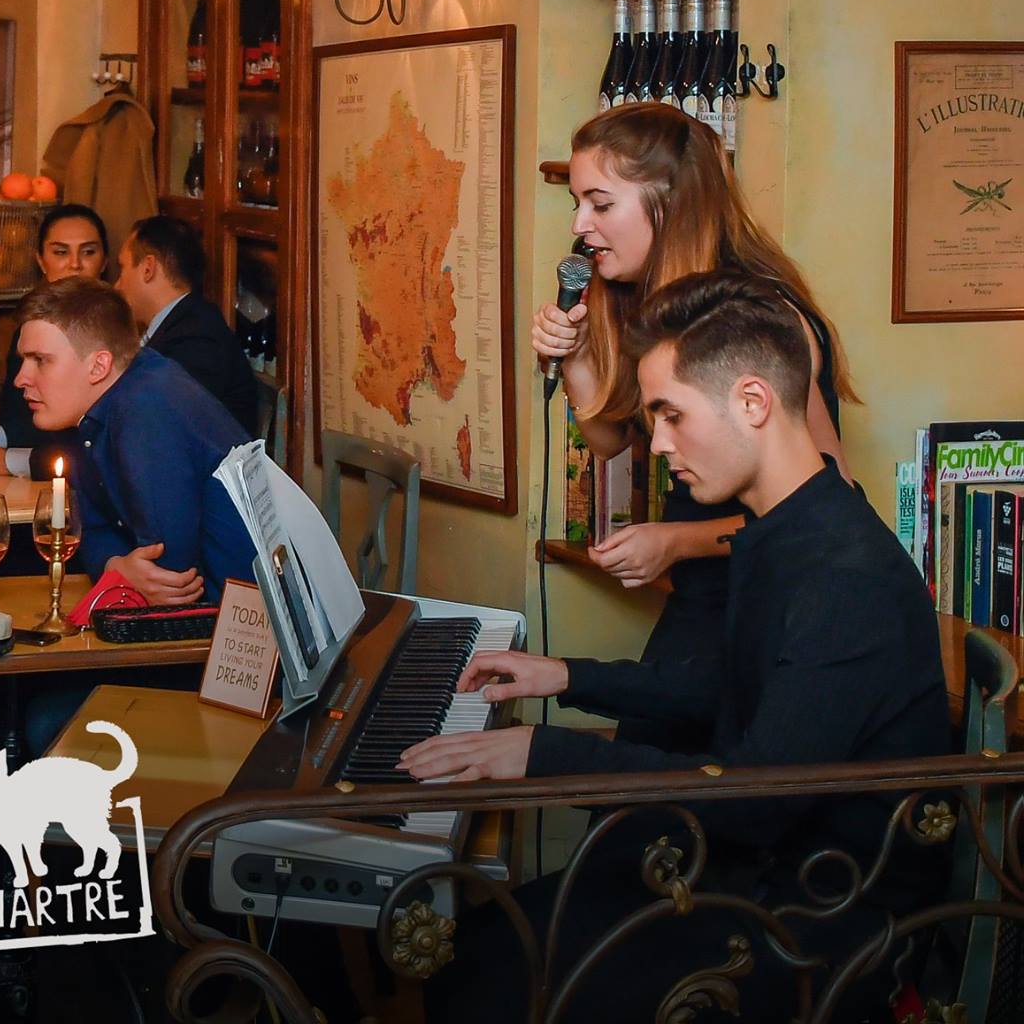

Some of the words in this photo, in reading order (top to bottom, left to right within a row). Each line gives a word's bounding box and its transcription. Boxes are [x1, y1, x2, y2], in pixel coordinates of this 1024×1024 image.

[916, 93, 1024, 134] L'ILLUSTRATI
[224, 638, 235, 650] TO
[237, 641, 266, 657] START
[216, 665, 259, 690] DREAMS
